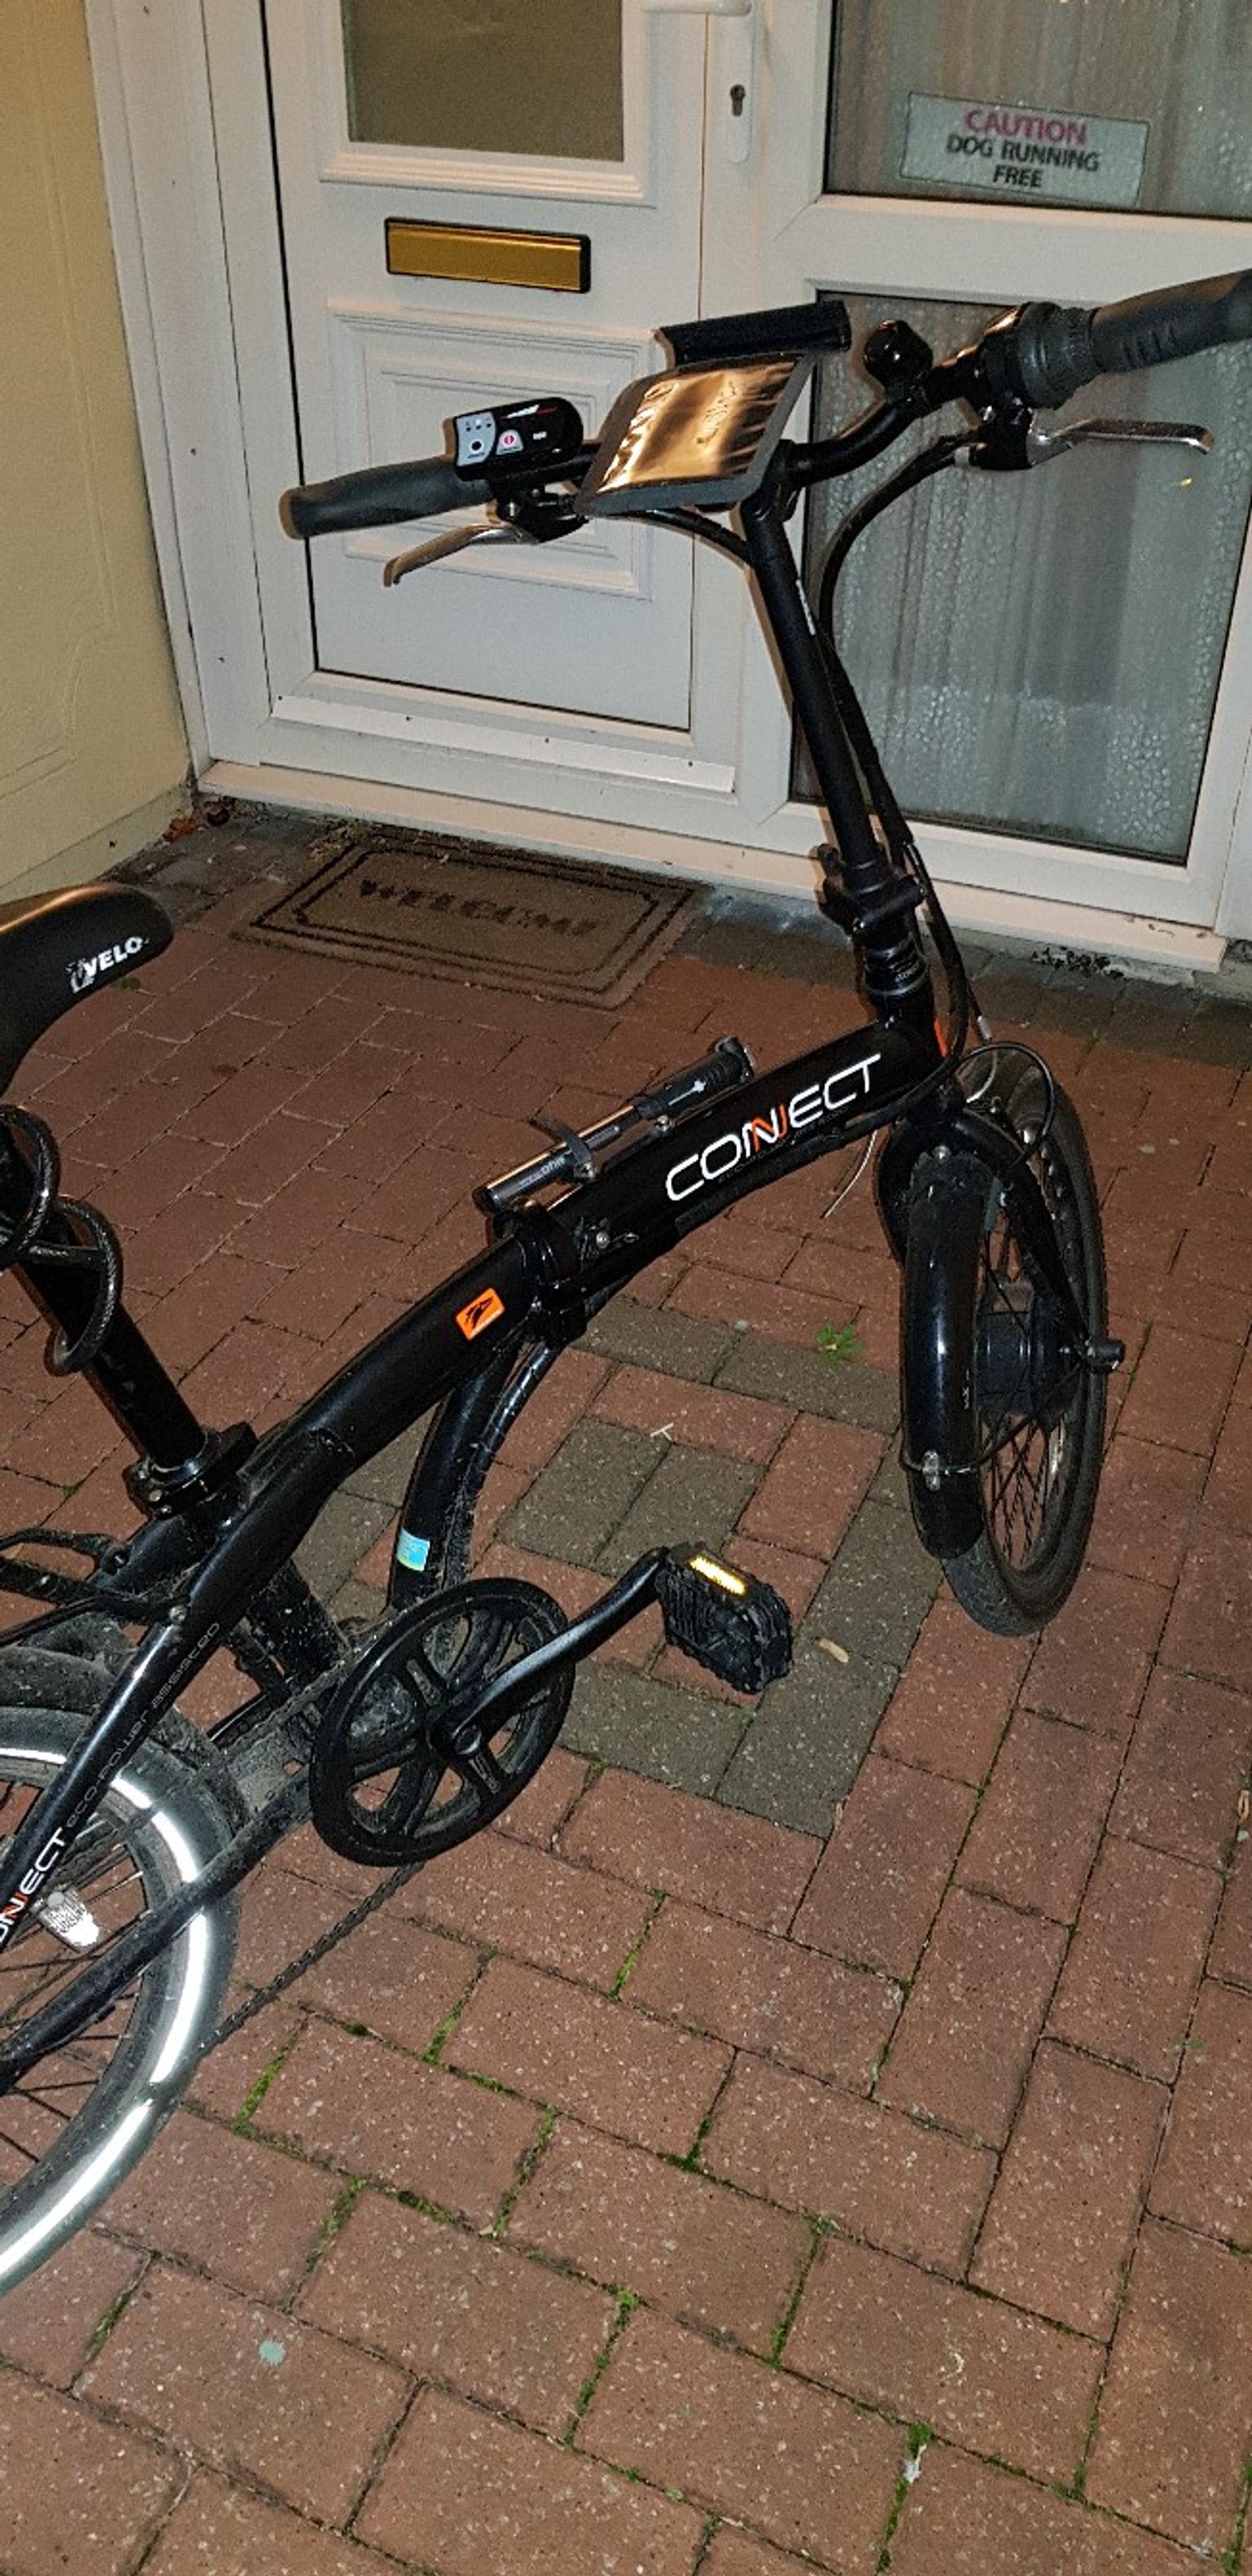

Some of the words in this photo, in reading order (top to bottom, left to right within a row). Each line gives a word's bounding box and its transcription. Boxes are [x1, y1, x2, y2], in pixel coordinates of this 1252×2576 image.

[964, 109, 1089, 145] CAUTION
[946, 133, 993, 158] DOG
[1001, 139, 1100, 172] RUNNING
[993, 165, 1043, 188] FREE
[83, 936, 144, 977] VELO
[664, 1053, 882, 1201] CONNECT
